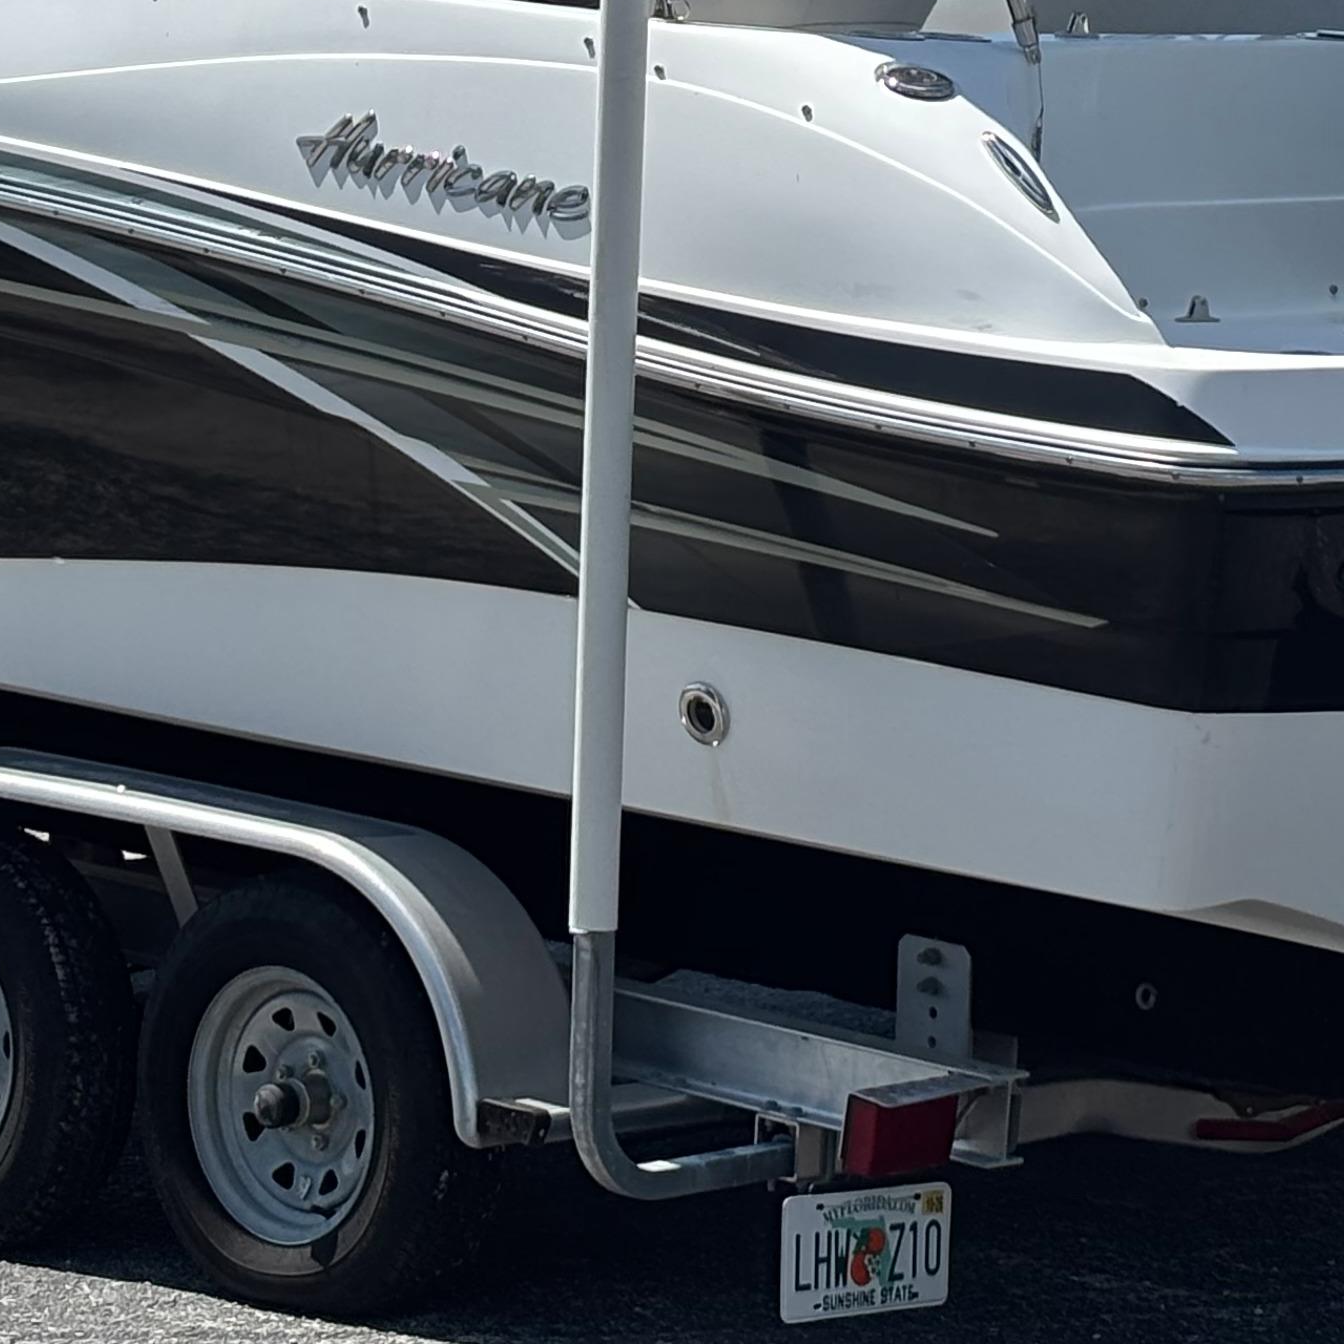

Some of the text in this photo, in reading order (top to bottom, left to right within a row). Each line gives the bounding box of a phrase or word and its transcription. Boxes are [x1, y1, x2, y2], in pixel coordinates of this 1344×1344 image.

[296, 108, 590, 222] Hurricane
[795, 1219, 942, 1292] LHW Z10
[822, 1285, 914, 1311] SUNSHINE STATE
